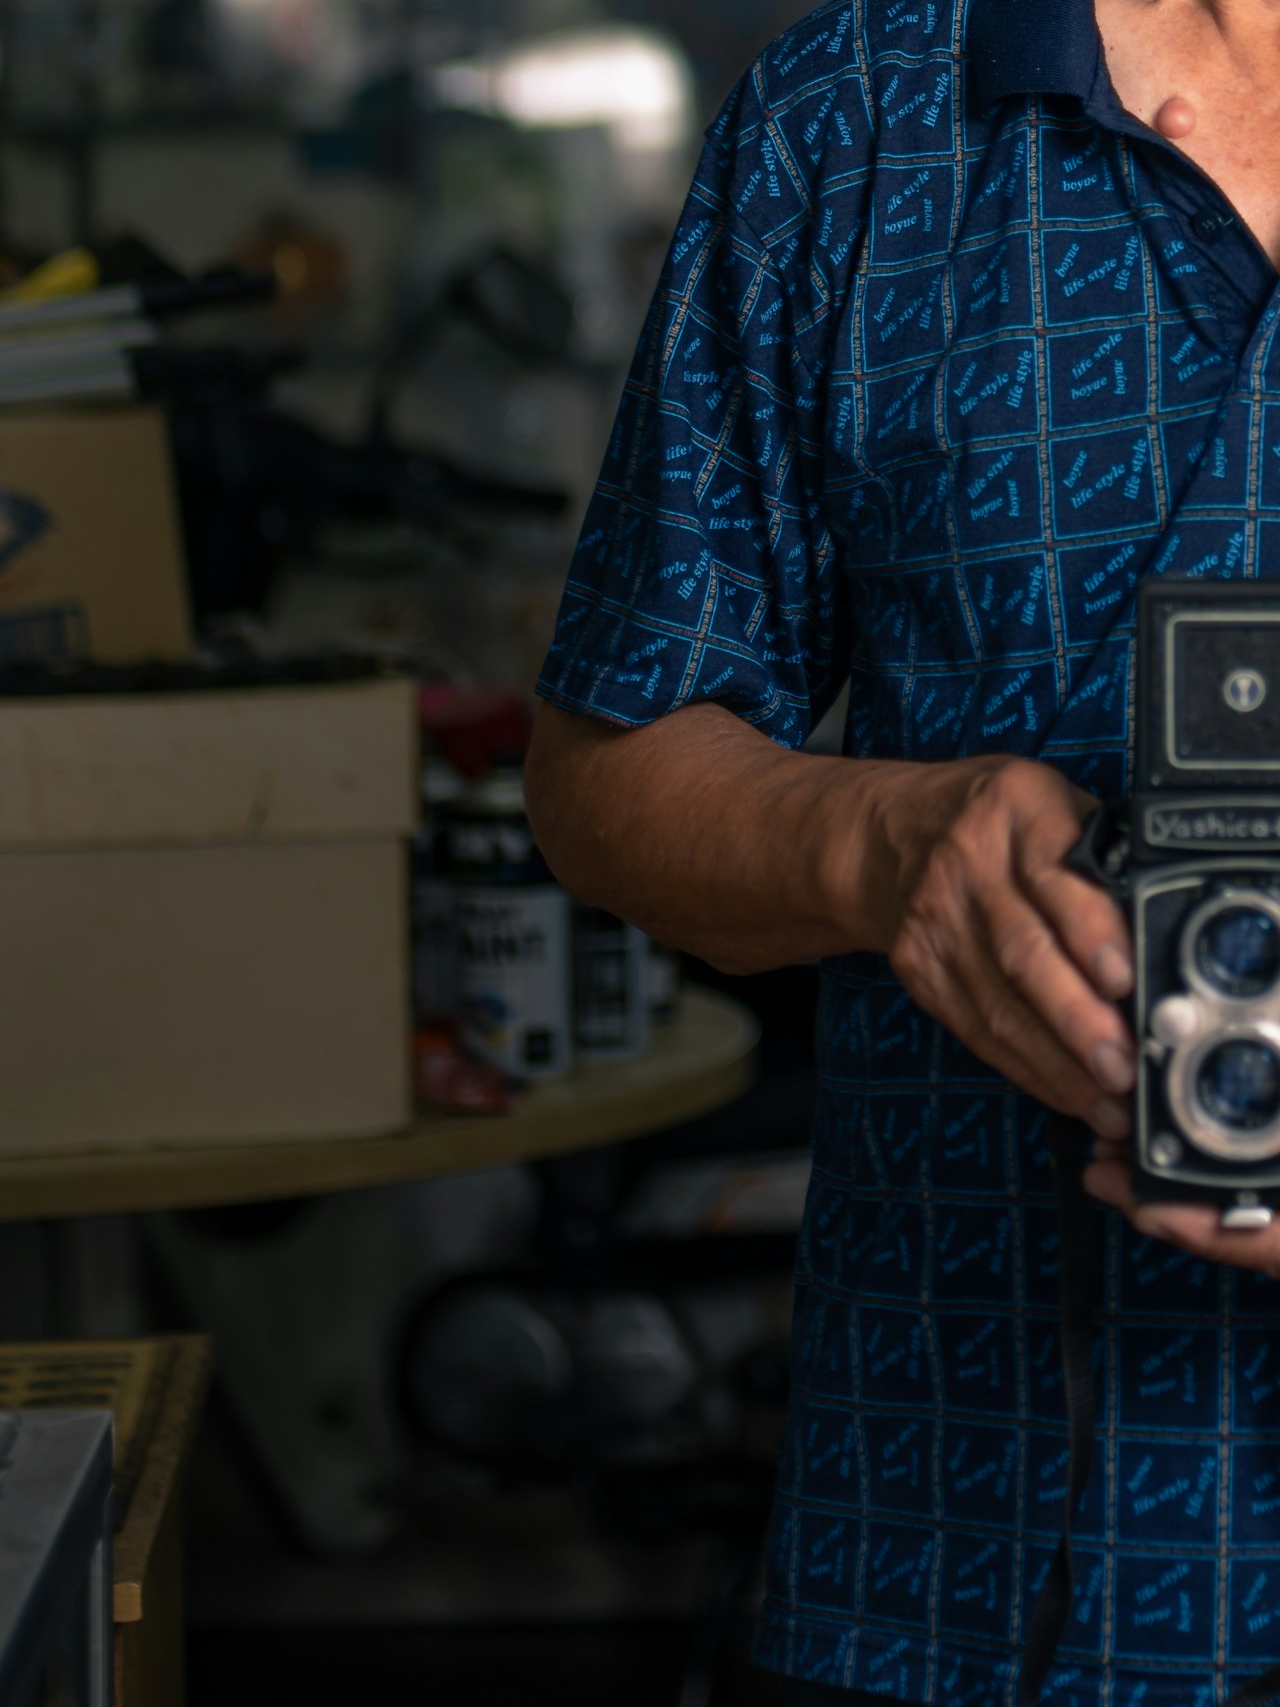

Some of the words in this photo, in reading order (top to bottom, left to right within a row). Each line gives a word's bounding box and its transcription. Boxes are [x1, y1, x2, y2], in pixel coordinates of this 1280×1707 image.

[804, 120, 820, 145] life
[818, 88, 837, 118] style
[921, 105, 939, 128] life
[934, 72, 949, 105] style
[834, 111, 854, 146] boyue
[886, 194, 902, 214] life
[903, 170, 930, 197] style
[1062, 174, 1098, 192] boyue
[818, 207, 834, 246] boyue
[884, 216, 917, 234] boyue
[1055, 243, 1080, 278] boyue
[1064, 278, 1084, 298] life
[1088, 258, 1116, 282] style
[1072, 358, 1092, 378] life
[1094, 332, 1122, 359] style
[954, 362, 978, 396] boyue
[960, 396, 978, 416] life
[980, 373, 1008, 398] style
[1006, 386, 1024, 408] life
[1017, 350, 1033, 385] style
[1070, 377, 1107, 400] boyue
[968, 478, 986, 499] life
[986, 452, 1014, 480] style
[1062, 450, 1088, 488] boyue
[1072, 488, 1093, 508] life
[1094, 464, 1125, 490] style
[1124, 476, 1140, 499] life
[1133, 438, 1148, 473] style
[712, 484, 742, 509] boyue
[970, 498, 1002, 521] boyue
[1007, 480, 1020, 517] boyue
[676, 578, 696, 600] life
[694, 549, 711, 578] style
[1084, 572, 1105, 593] life
[1106, 544, 1135, 574] style
